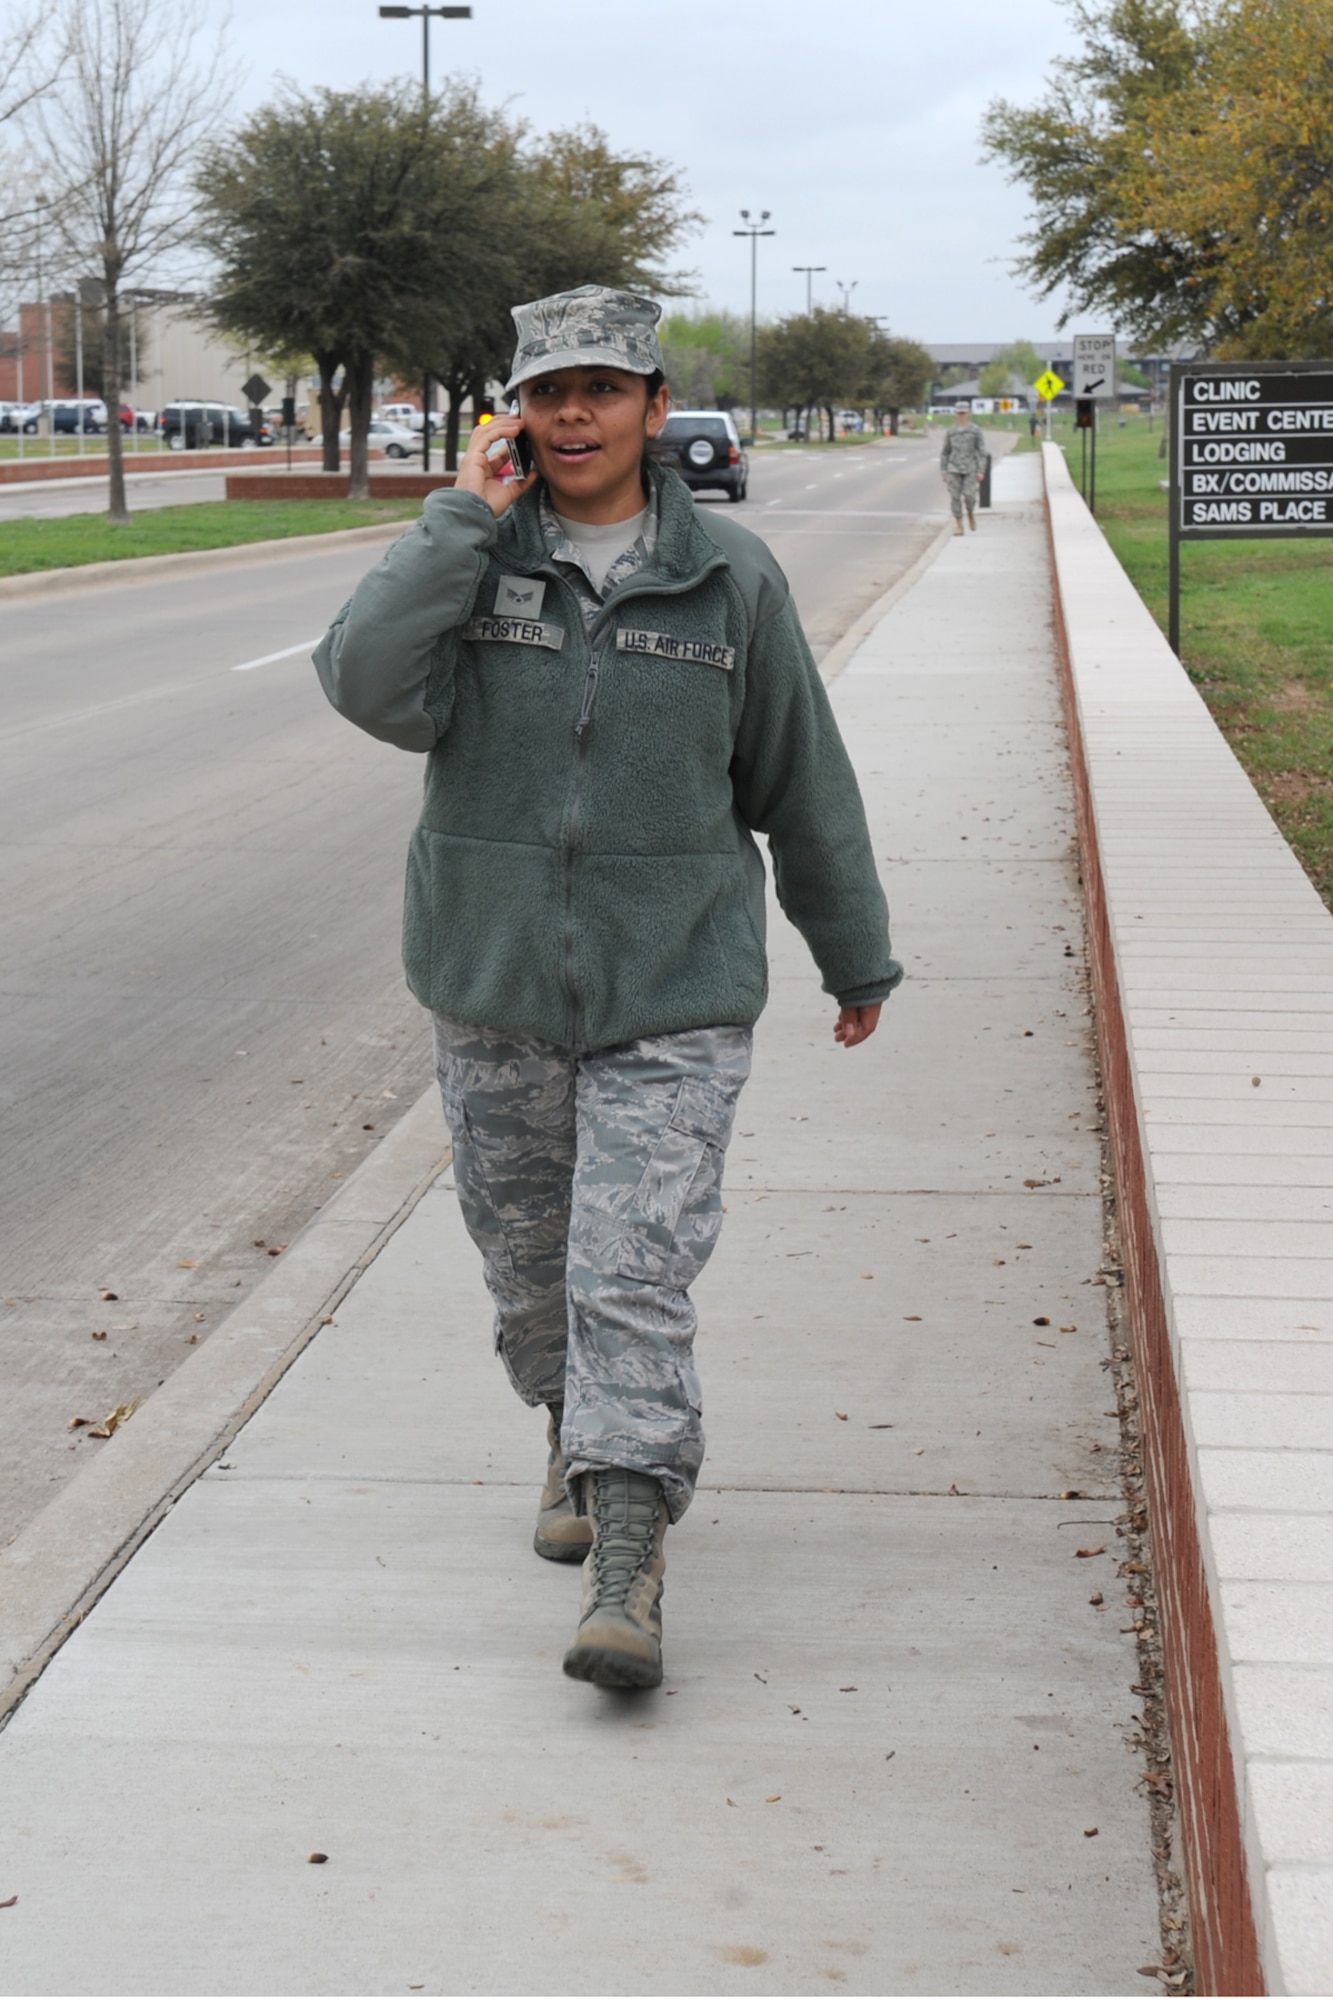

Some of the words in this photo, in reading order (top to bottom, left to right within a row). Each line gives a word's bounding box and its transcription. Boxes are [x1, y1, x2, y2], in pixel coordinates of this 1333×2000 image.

[1079, 340, 1111, 351] STOP
[1082, 364, 1106, 374] RED
[1193, 381, 1260, 401] CLINIC
[1193, 411, 1260, 431] EVENT
[1192, 442, 1286, 463] LODGING
[1192, 502, 1252, 522] SAMS
[1260, 501, 1326, 521] PLACE
[481, 621, 543, 641] FOSTER
[624, 632, 651, 650] U.S.
[654, 636, 679, 657] AIR
[683, 642, 730, 665] FORCE
